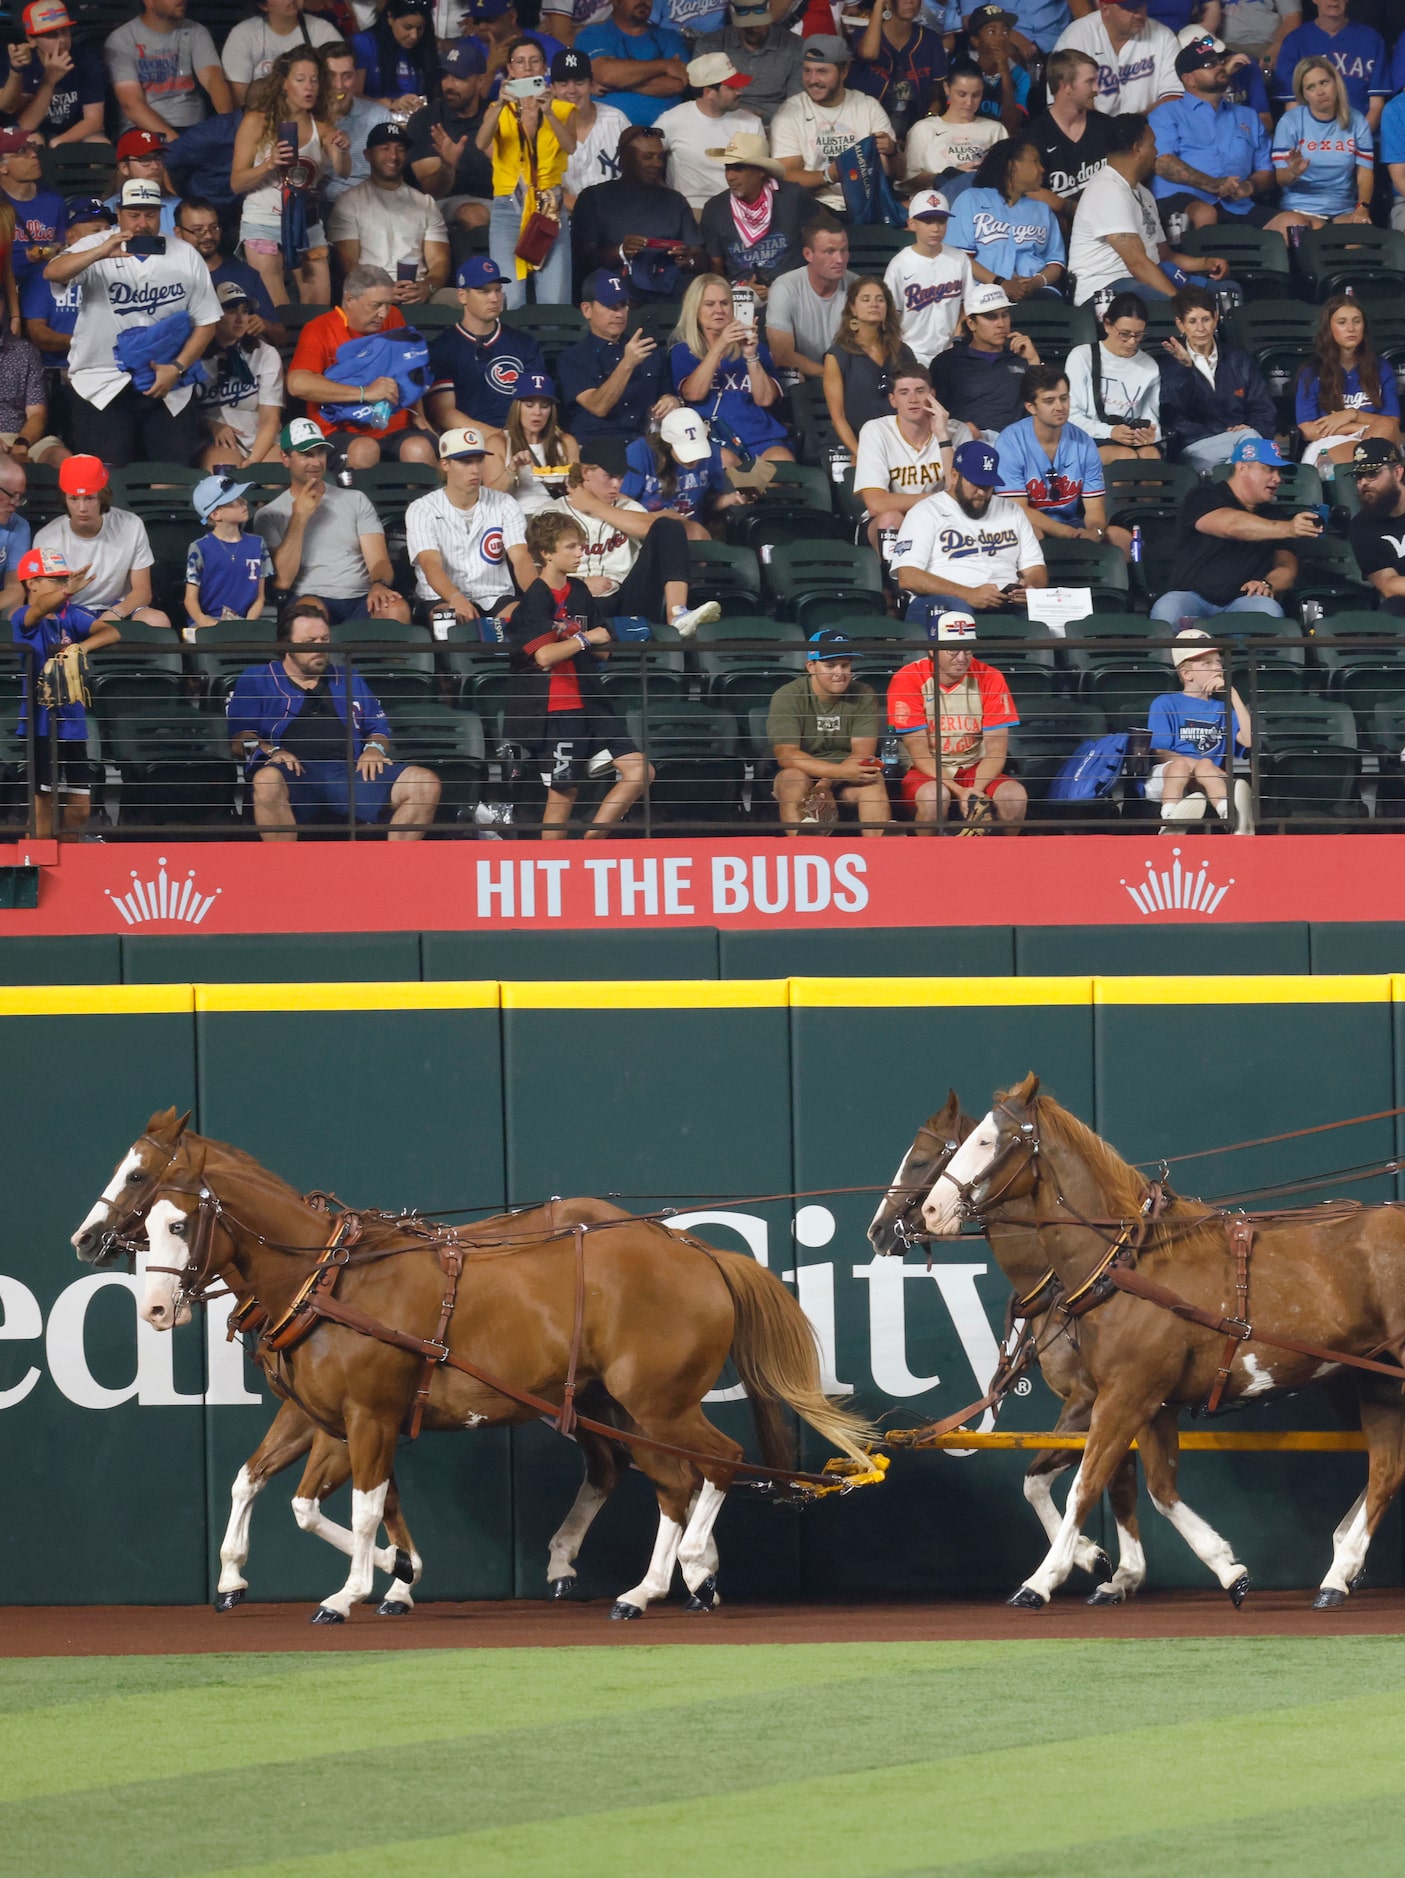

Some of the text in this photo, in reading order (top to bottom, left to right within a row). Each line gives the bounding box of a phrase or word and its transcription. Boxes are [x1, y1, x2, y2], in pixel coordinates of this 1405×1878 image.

[1050, 158, 1107, 198] Dodger
[973, 212, 1047, 245] Rangers
[608, 278, 621, 290] T
[109, 282, 187, 316] Dodgers
[193, 375, 259, 408] Dodger
[532, 376, 544, 388] T
[710, 373, 753, 391] EXA
[685, 427, 697, 440] T
[890, 462, 943, 488] PIRAT
[939, 528, 1019, 560] Dodgers
[246, 559, 260, 580] T
[477, 853, 869, 917] HIT THE BUDS
